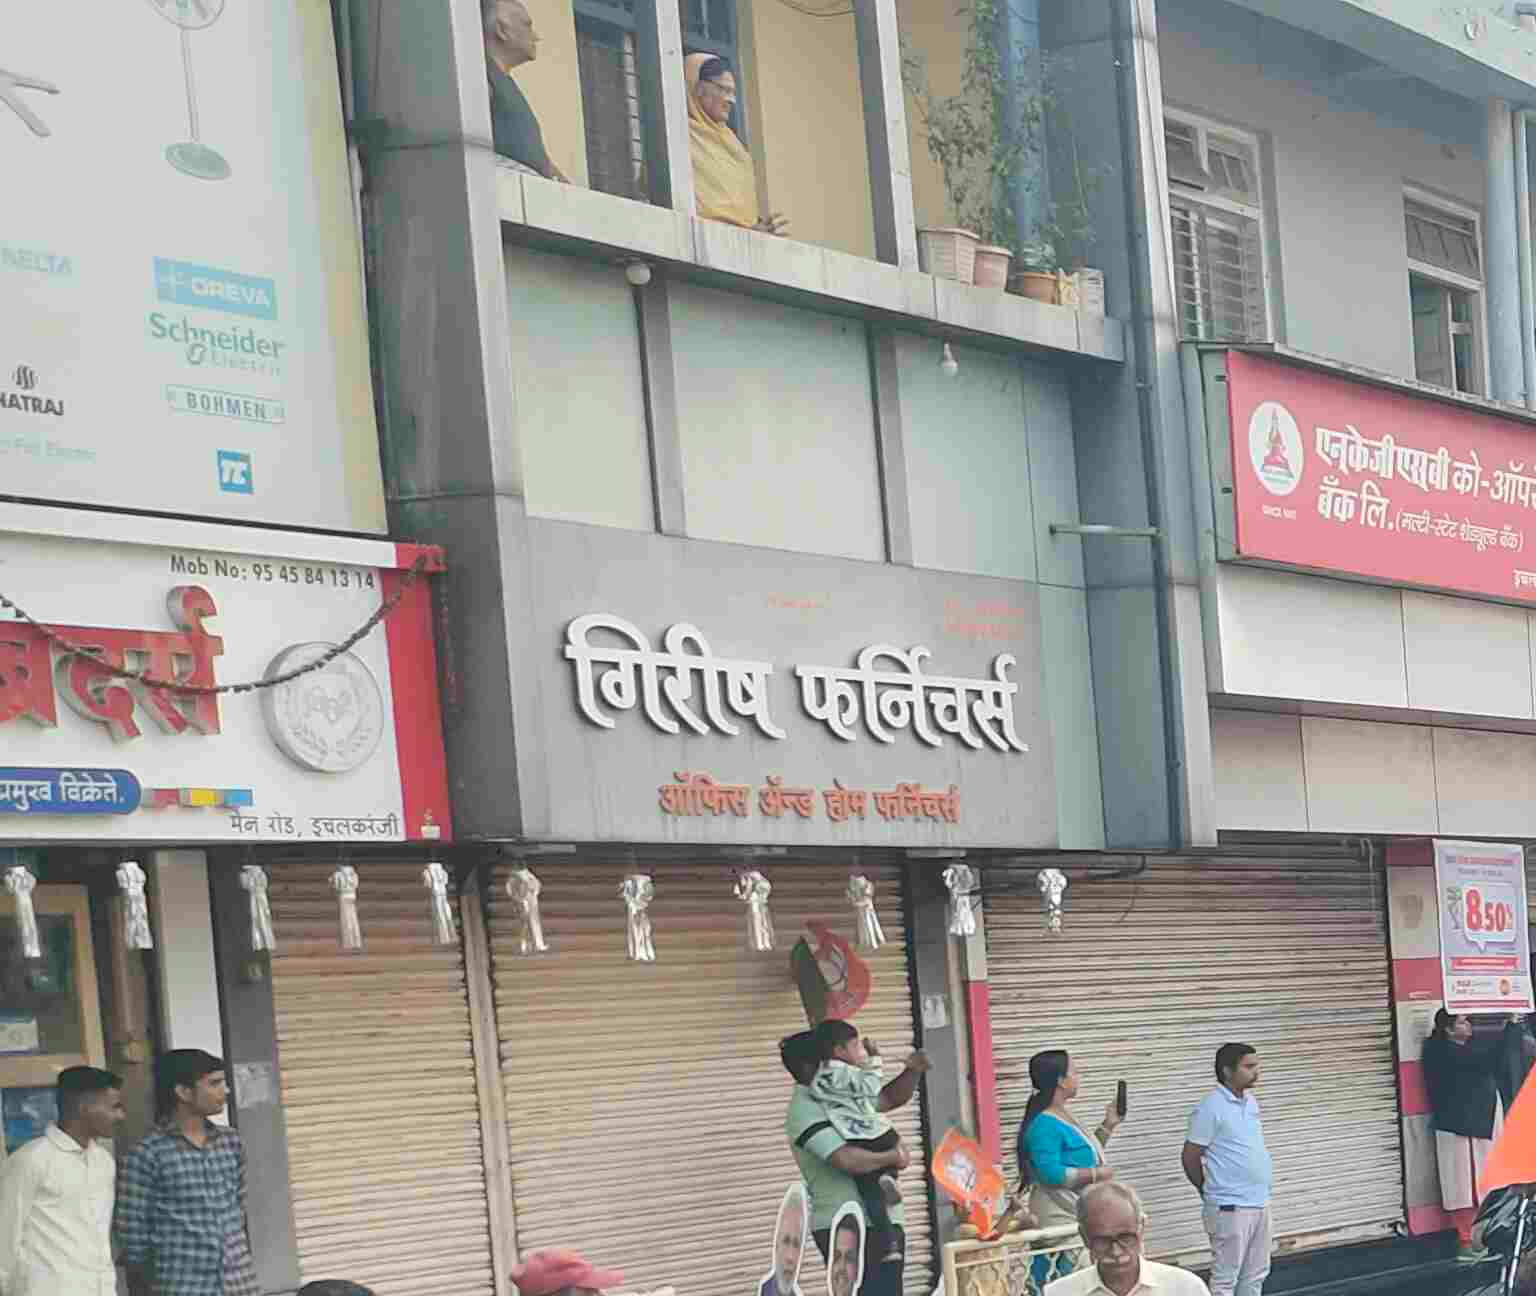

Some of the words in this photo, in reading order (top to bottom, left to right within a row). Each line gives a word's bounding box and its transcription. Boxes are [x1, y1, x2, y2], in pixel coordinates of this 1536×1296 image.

[149, 312, 285, 360] Schneider
[186, 391, 267, 421] BOHMEN
[169, 554, 209, 577] Mob
[213, 558, 249, 582] No:
[252, 561, 274, 584] 95
[278, 563, 300, 585] 45
[304, 565, 325, 586] 84
[329, 567, 350, 589] 13
[353, 568, 376, 590] 14
[564, 612, 786, 741] गिरीष
[795, 643, 1030, 754] फर्निचर्स
